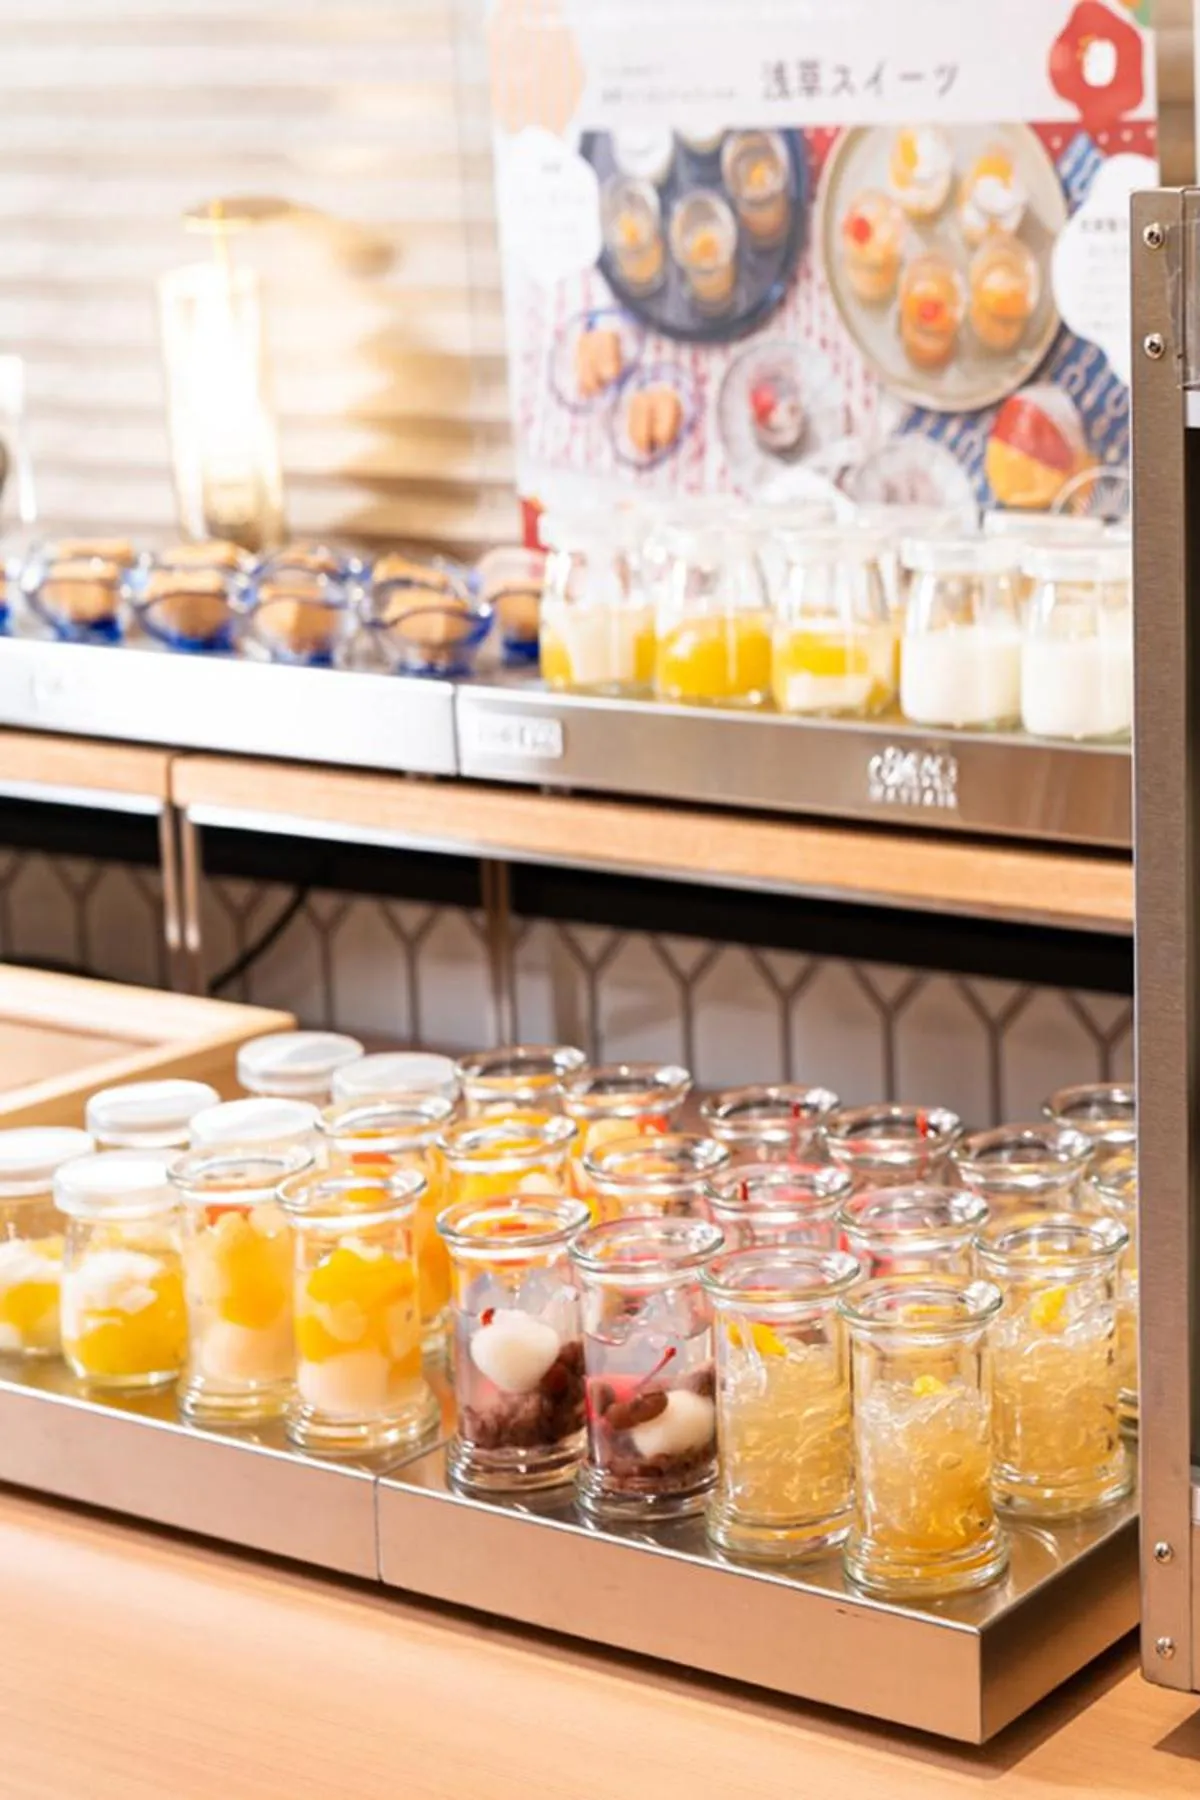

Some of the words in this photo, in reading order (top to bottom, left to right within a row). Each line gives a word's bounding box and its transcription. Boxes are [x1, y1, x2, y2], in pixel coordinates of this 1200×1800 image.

[762, 57, 960, 100] 浅草スイーツ
